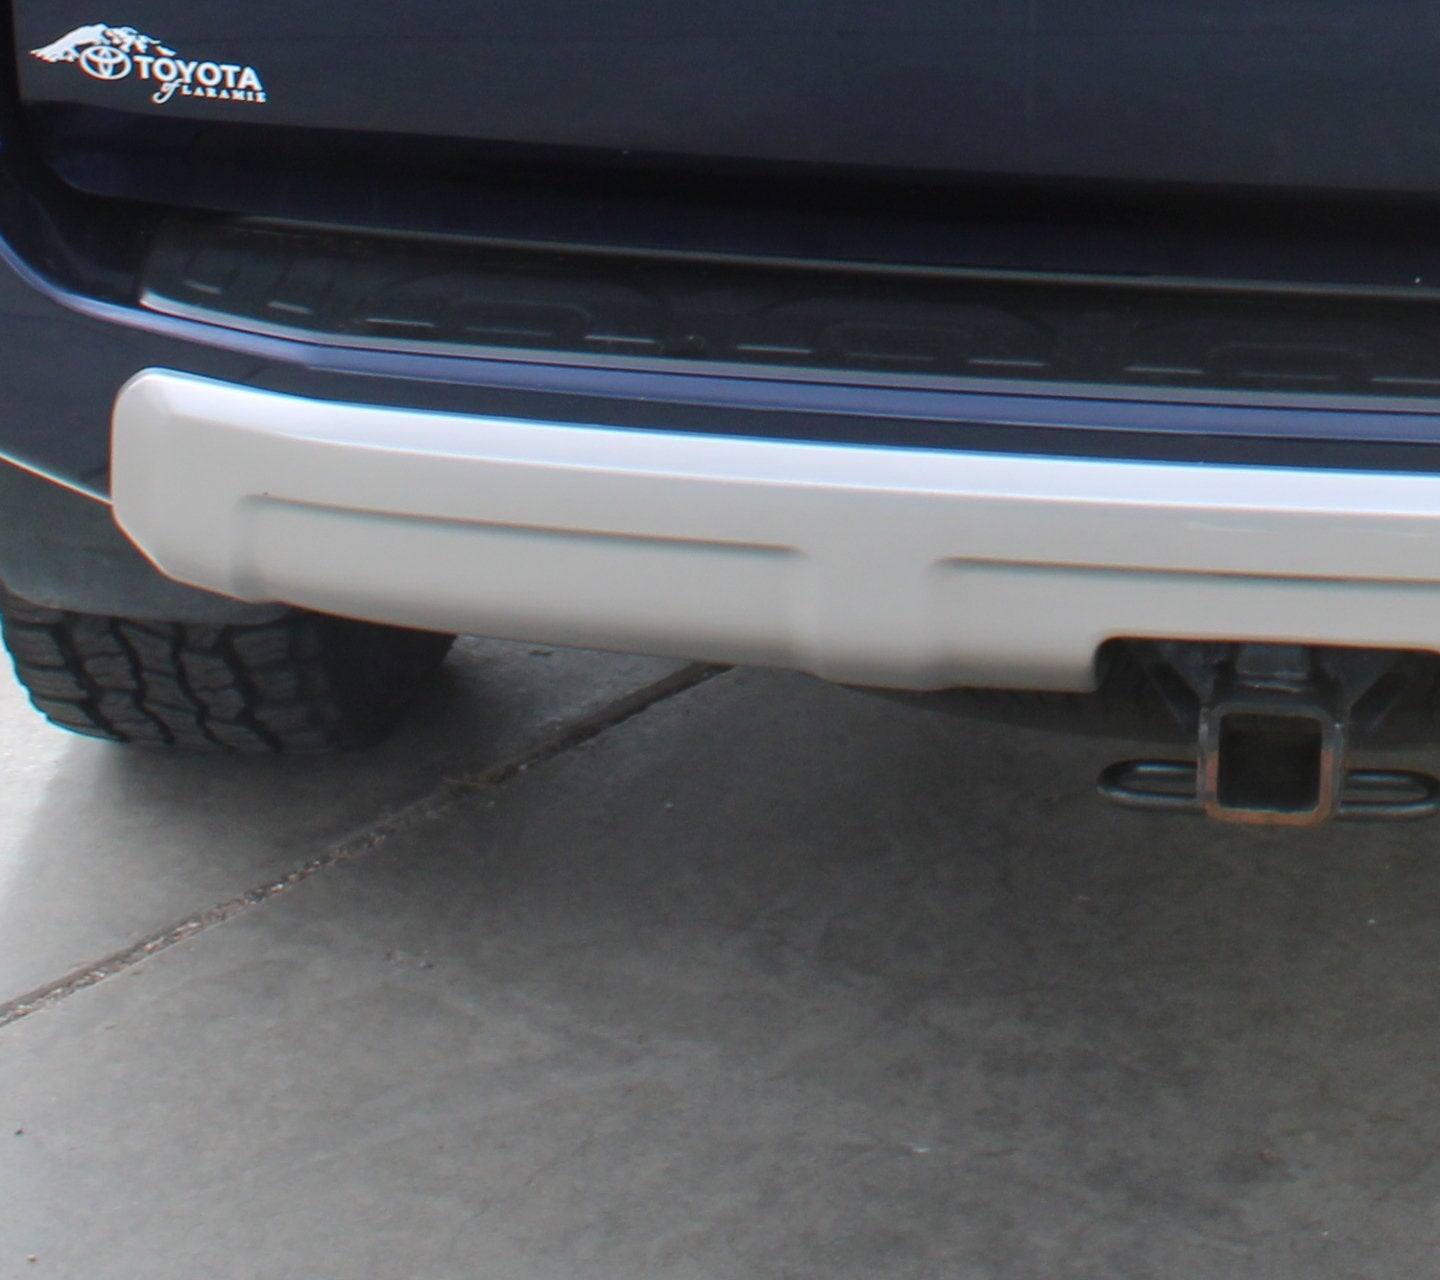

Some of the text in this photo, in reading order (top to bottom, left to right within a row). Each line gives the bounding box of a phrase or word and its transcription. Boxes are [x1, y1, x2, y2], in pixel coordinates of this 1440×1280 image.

[133, 55, 263, 91] TOYOTA
[151, 78, 266, 104] of LARAMIE
